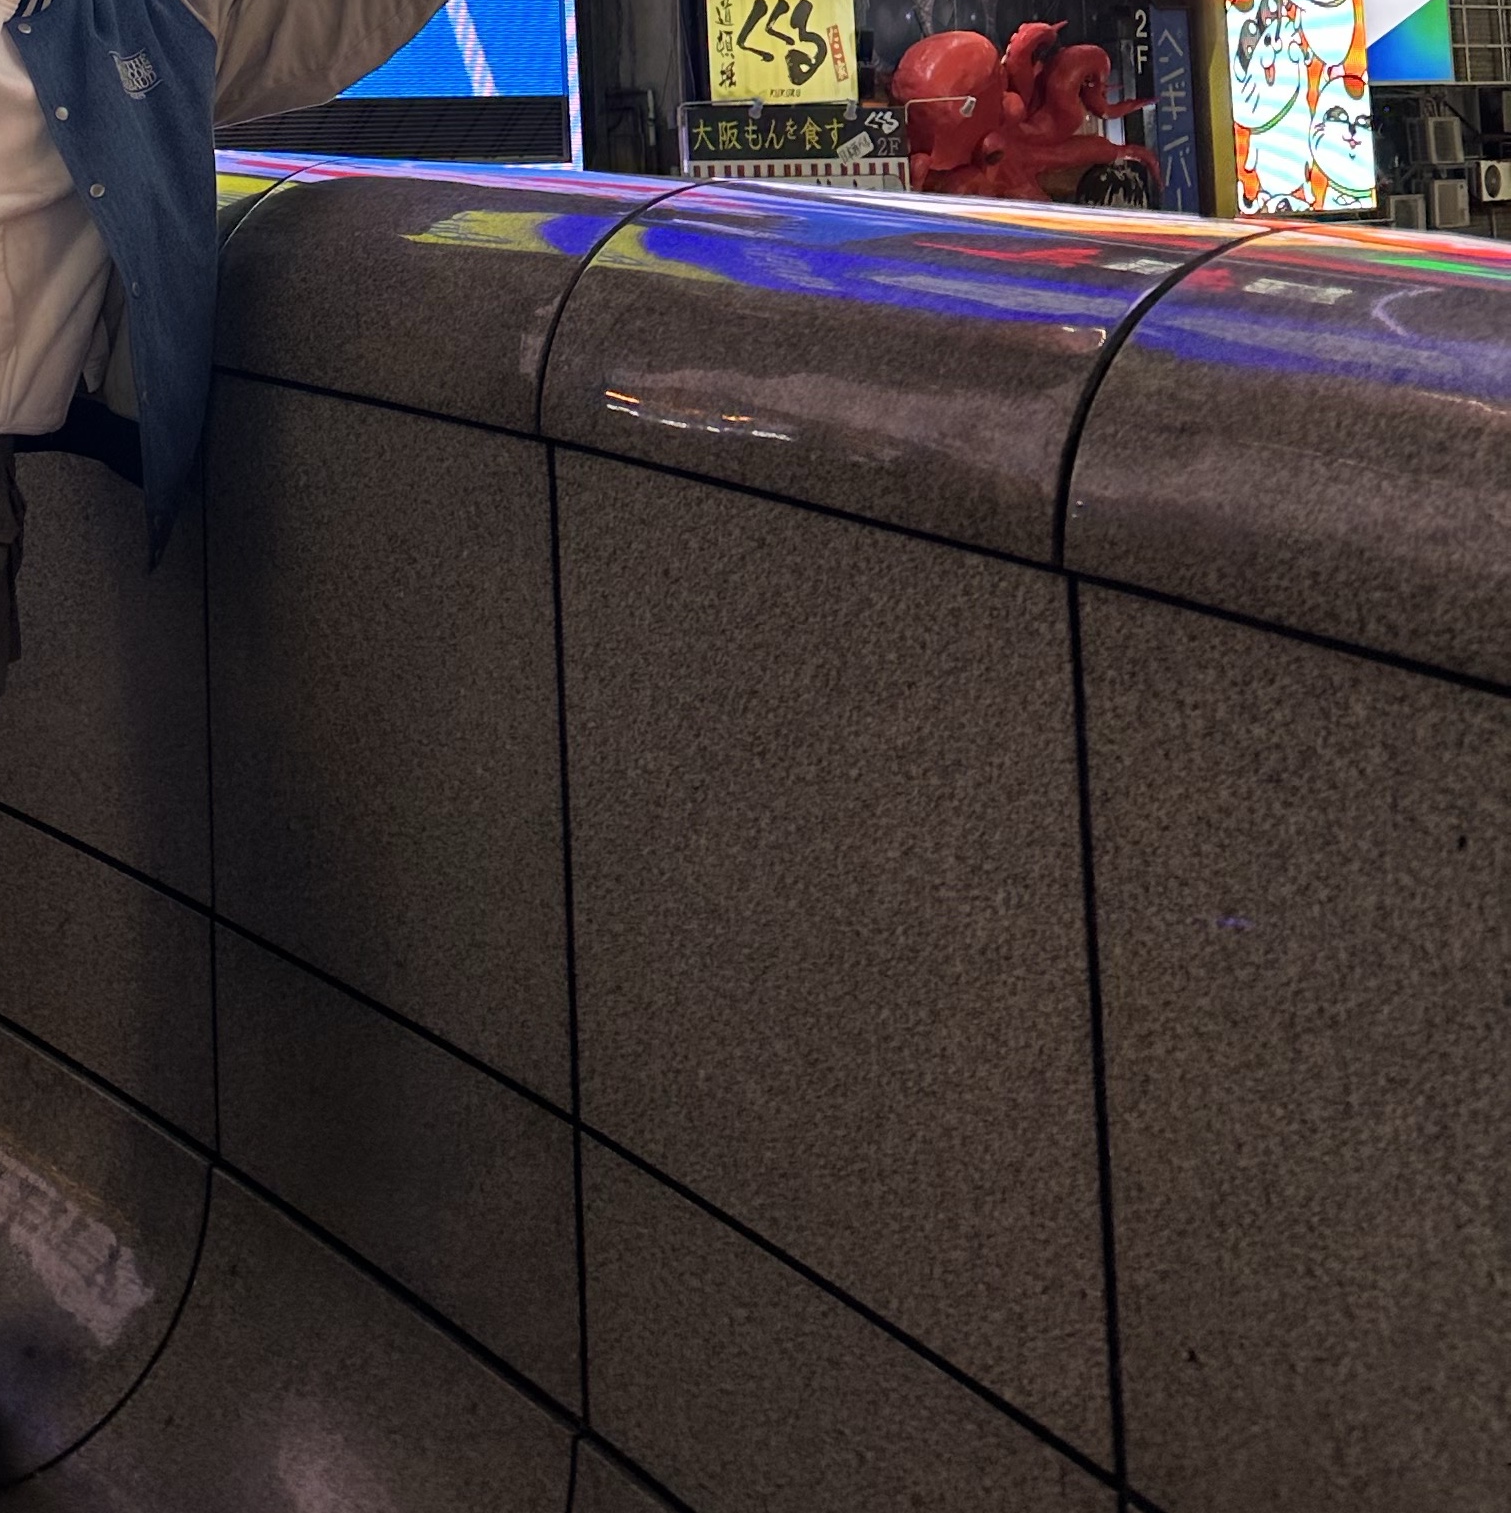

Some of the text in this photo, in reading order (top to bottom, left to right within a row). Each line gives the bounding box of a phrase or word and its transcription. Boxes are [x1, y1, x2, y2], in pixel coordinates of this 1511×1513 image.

[692, 117, 844, 151] 大阪もんを食す
[877, 138, 901, 156] 2F
